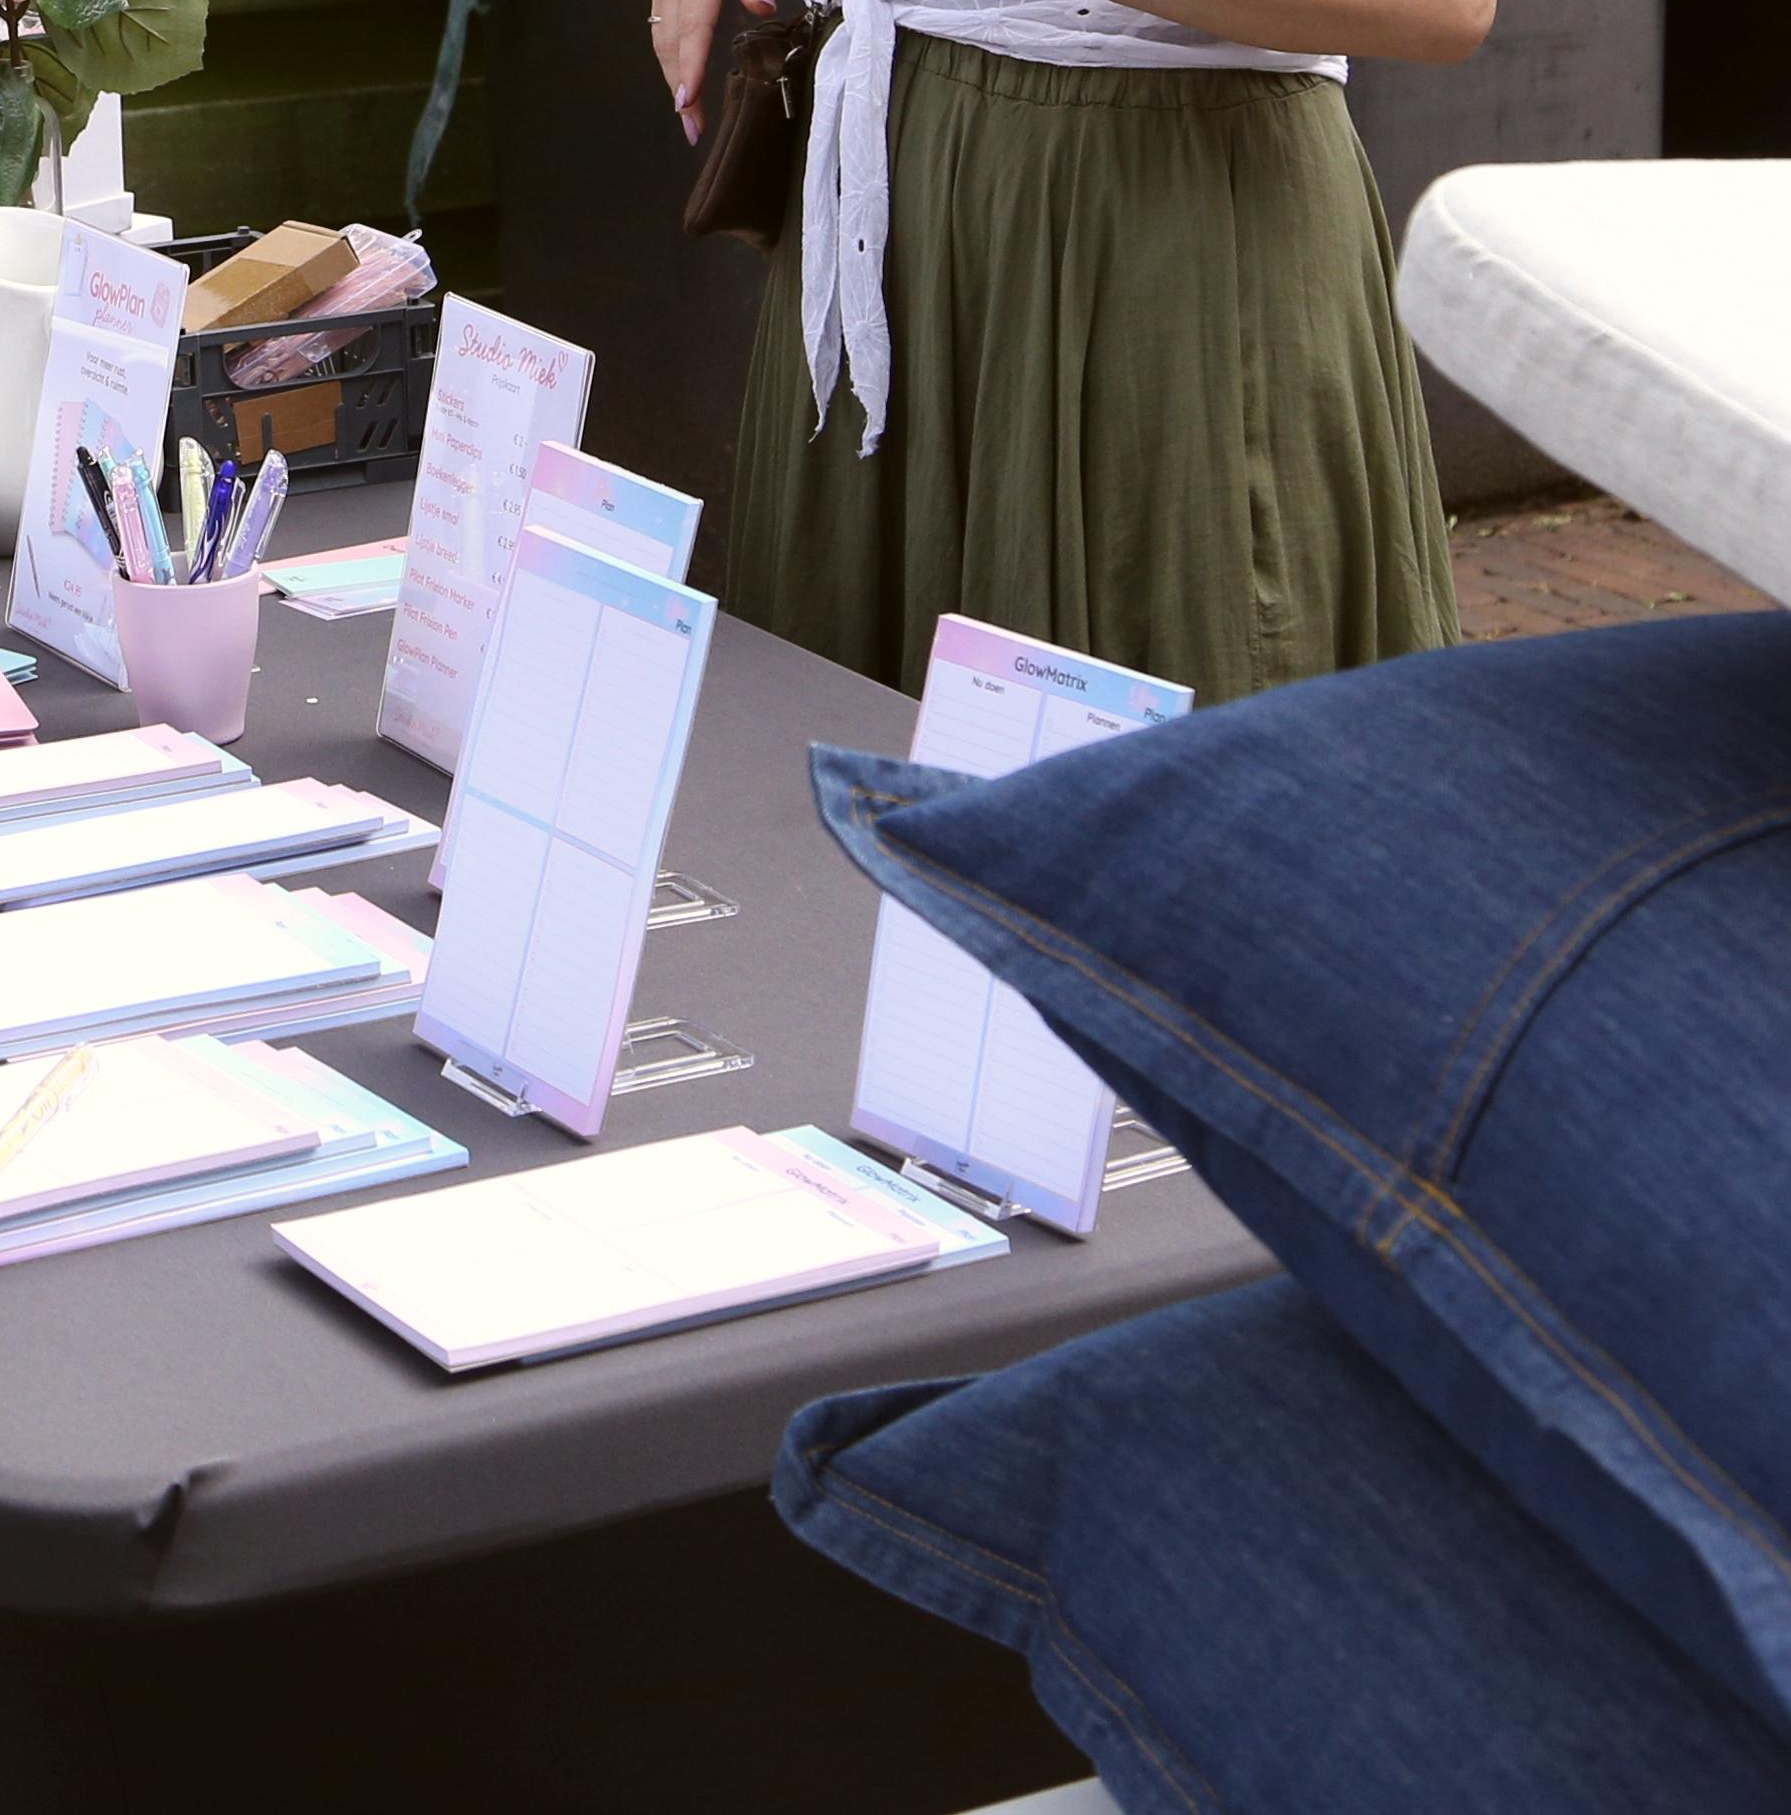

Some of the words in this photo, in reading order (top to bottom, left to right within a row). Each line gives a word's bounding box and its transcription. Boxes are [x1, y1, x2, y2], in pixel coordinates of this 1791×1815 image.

[90, 271, 146, 319] GlowPlan
[86, 351, 99, 365] Voor
[100, 357, 114, 372] meer
[459, 323, 513, 371] Studio
[518, 347, 558, 390] Miek
[81, 366, 105, 385] overzicht
[437, 388, 465, 412] Stickers
[446, 433, 483, 460] Paperclips
[442, 507, 459, 526] smal
[601, 498, 615, 512] Plan
[437, 541, 459, 564] breed
[410, 567, 425, 586] Pilot
[450, 589, 475, 612] Marker
[403, 602, 418, 622] Pilot
[444, 623, 459, 641] Pen
[675, 618, 692, 635] Plan
[397, 638, 430, 665] GlowPlan
[431, 656, 459, 680] Planner
[1014, 655, 1089, 693] GlowMatrix
[986, 680, 1006, 696] doen
[1087, 711, 1122, 733] Plannen
[1144, 706, 1167, 724] Plan
[856, 1163, 922, 1204] GlowMatrix
